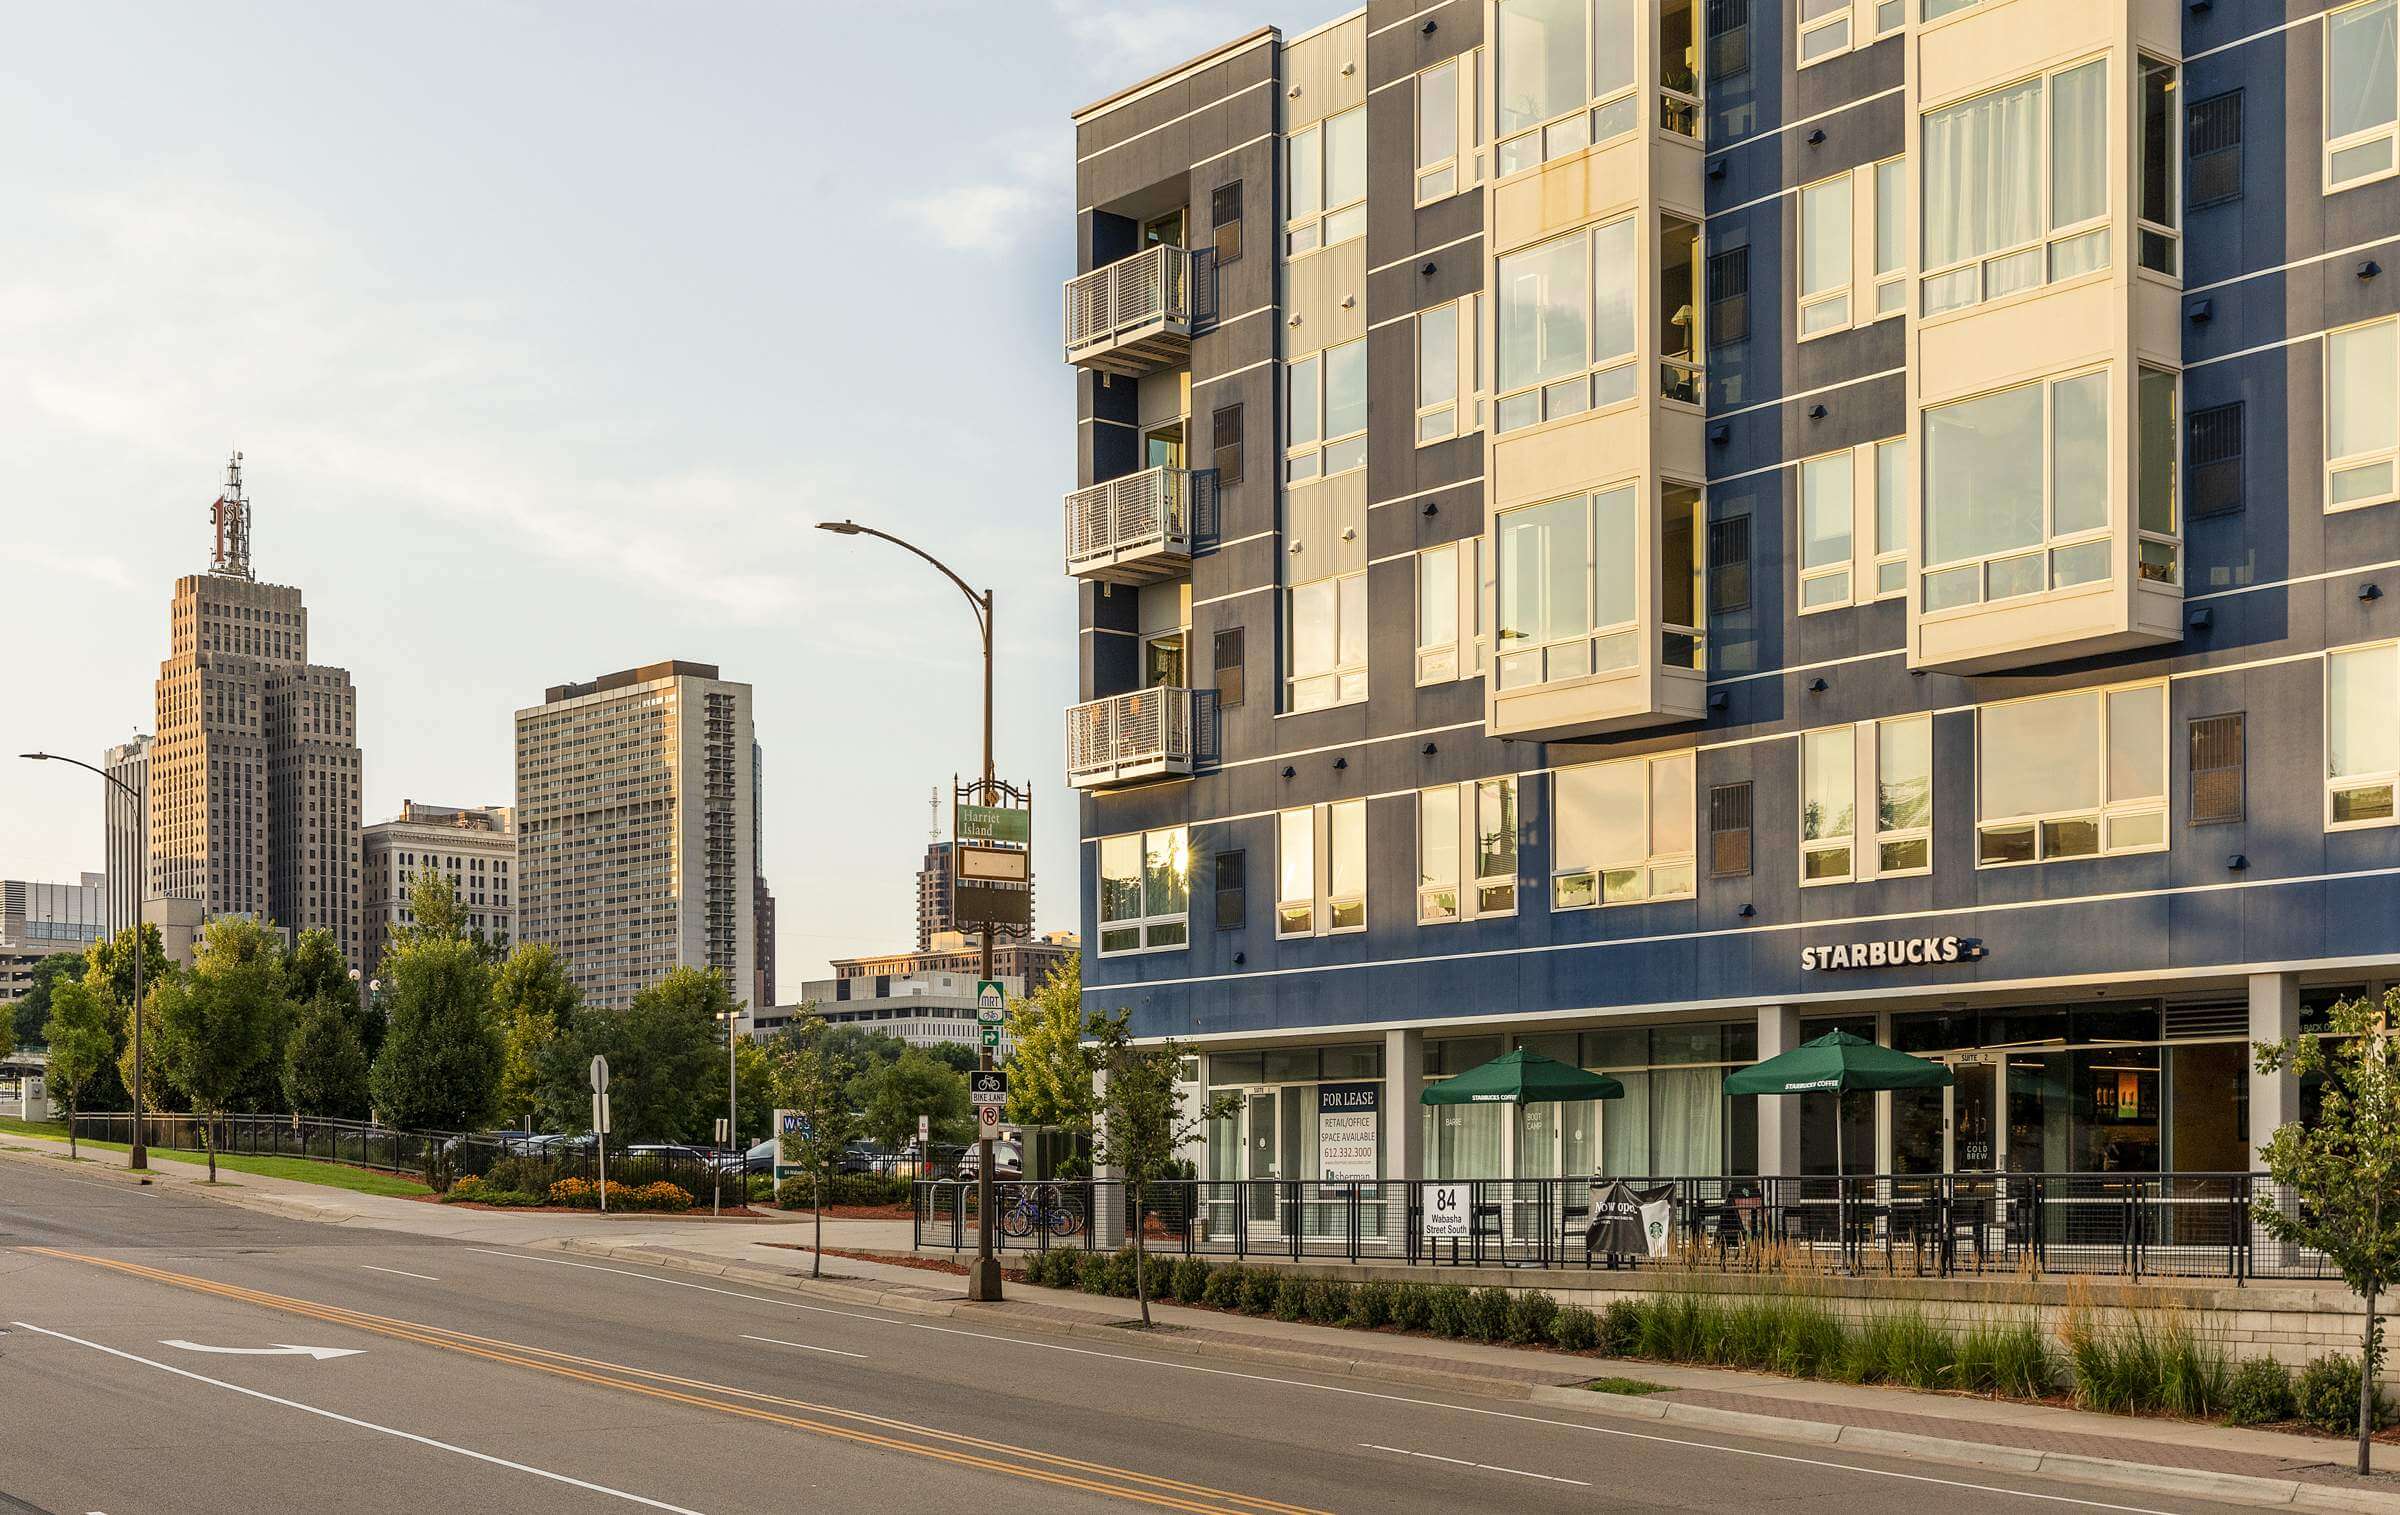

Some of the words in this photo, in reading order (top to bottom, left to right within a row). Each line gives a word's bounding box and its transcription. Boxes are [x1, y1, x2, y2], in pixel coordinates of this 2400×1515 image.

[963, 809, 1000, 824] Harriet
[963, 822, 993, 836] Island
[1801, 936, 1958, 971] STARBUCKS
[981, 995, 1000, 1008] MRT
[1961, 1054, 1978, 1062] SUITE
[973, 1093, 988, 1102] BIKE
[989, 1093, 1005, 1102] LANE
[1323, 1093, 1342, 1106] FOR
[1344, 1091, 1374, 1105] LEASE
[1325, 1117, 1370, 1128] RETAIL/OFFICE
[1321, 1132, 1341, 1142] SPACE
[1341, 1131, 1375, 1142] AVAILABLE
[1324, 1147, 1372, 1158] 612.332.3000
[1966, 1145, 1988, 1153] COLD
[1966, 1152, 1988, 1160] BREW
[1437, 1188, 1457, 1211] 84
[1594, 1201, 1616, 1214] Now
[1431, 1214, 1462, 1224] Wabasha
[1426, 1225, 1447, 1234] Street
[1447, 1225, 1467, 1234] South
